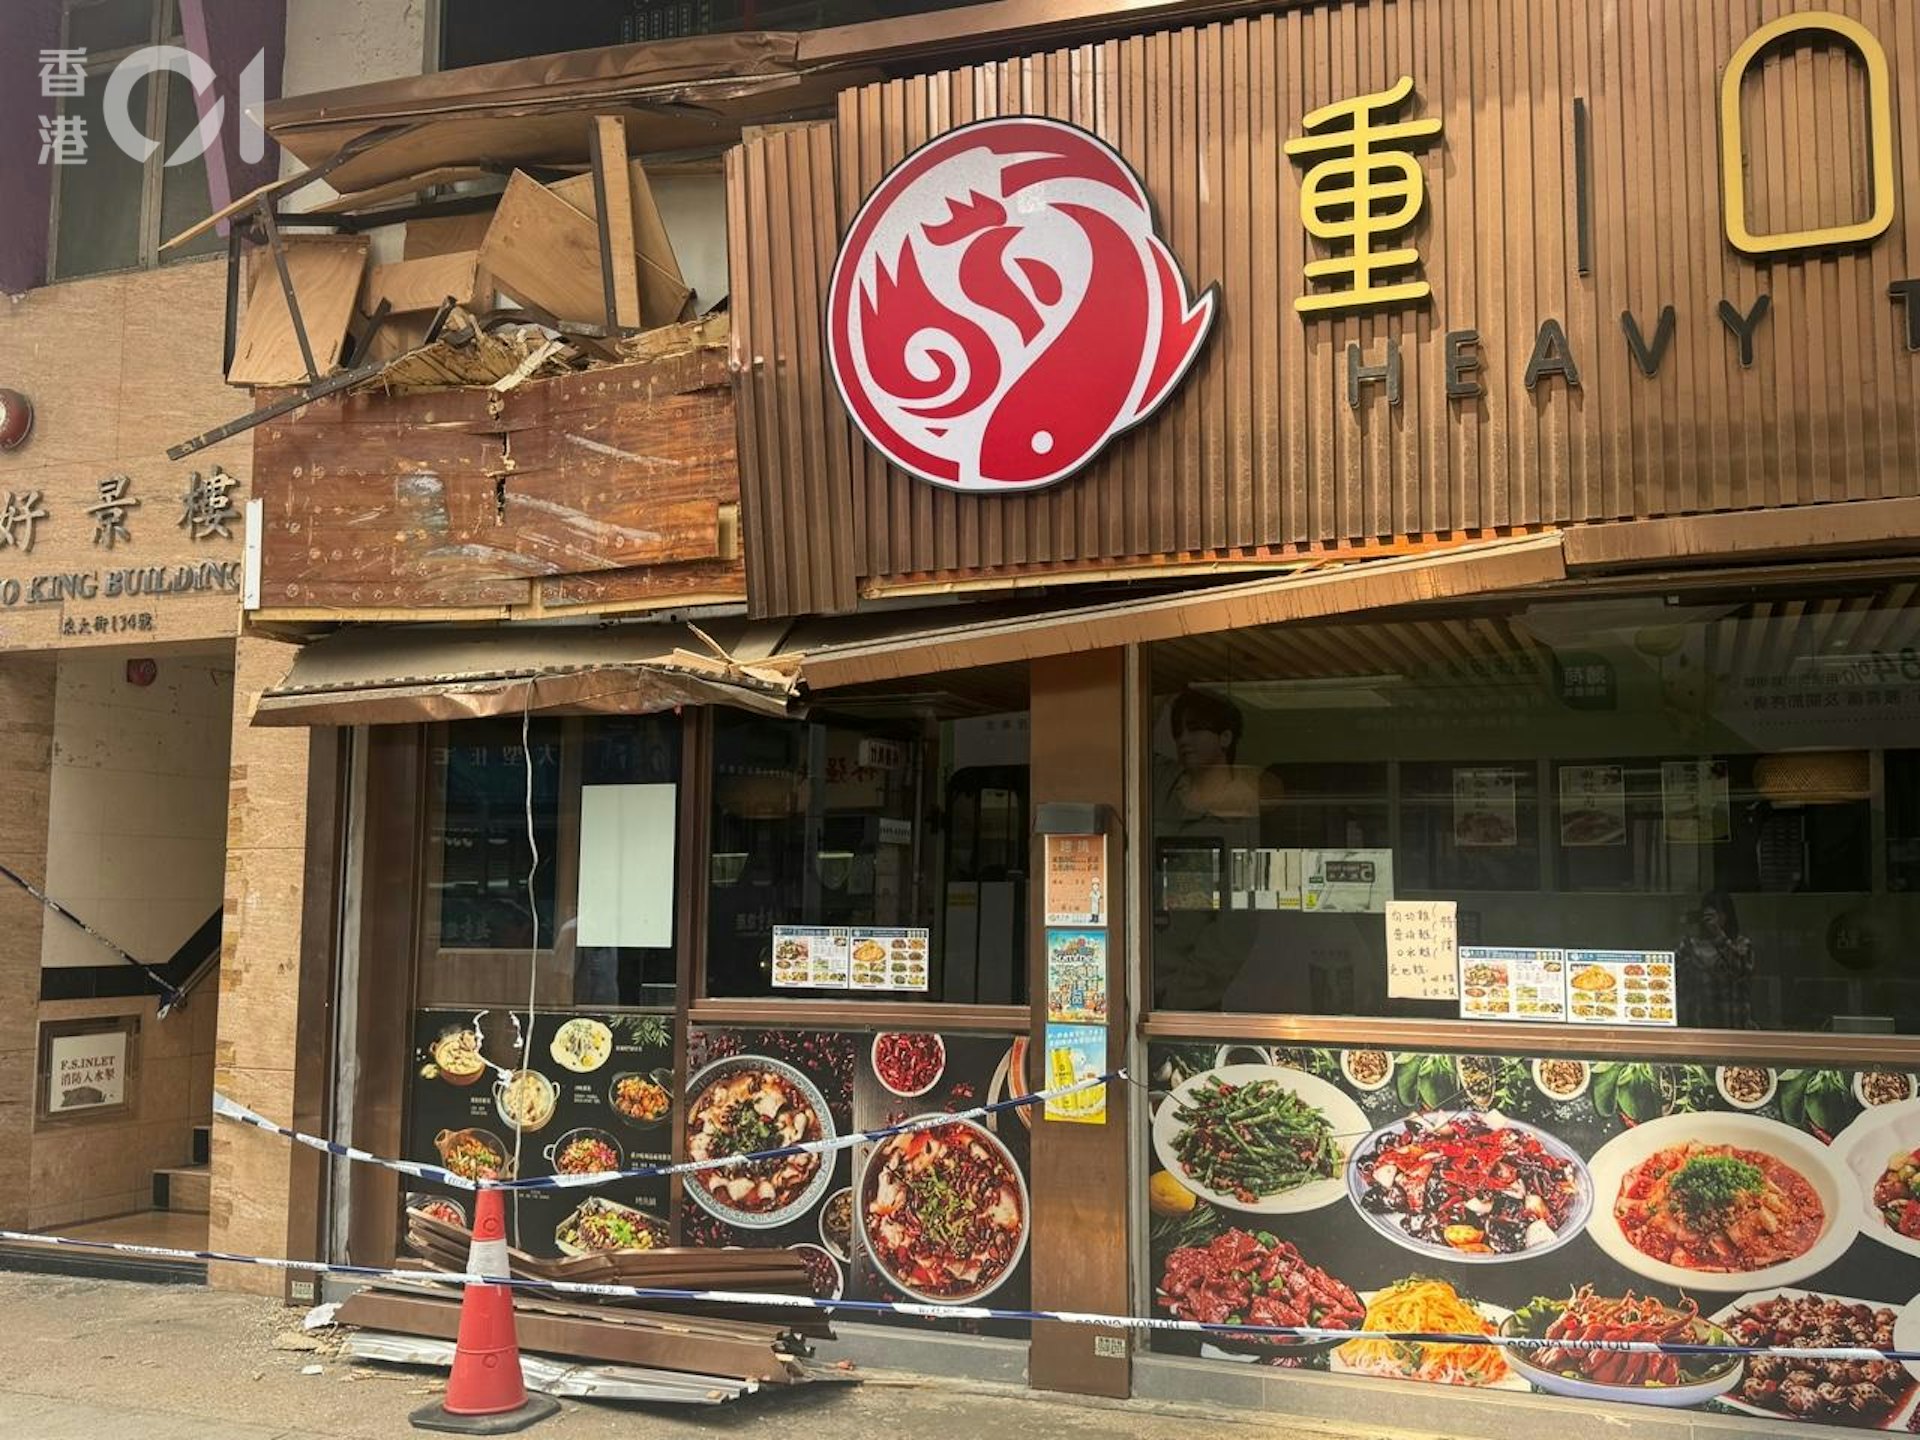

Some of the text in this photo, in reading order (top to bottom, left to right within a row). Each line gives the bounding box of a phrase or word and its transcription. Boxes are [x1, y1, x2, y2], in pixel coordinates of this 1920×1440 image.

[1284, 76, 1443, 313] 重
[1346, 294, 1771, 410] HEAVY
[0, 465, 242, 553] 好景樓
[25, 570, 98, 603] KING
